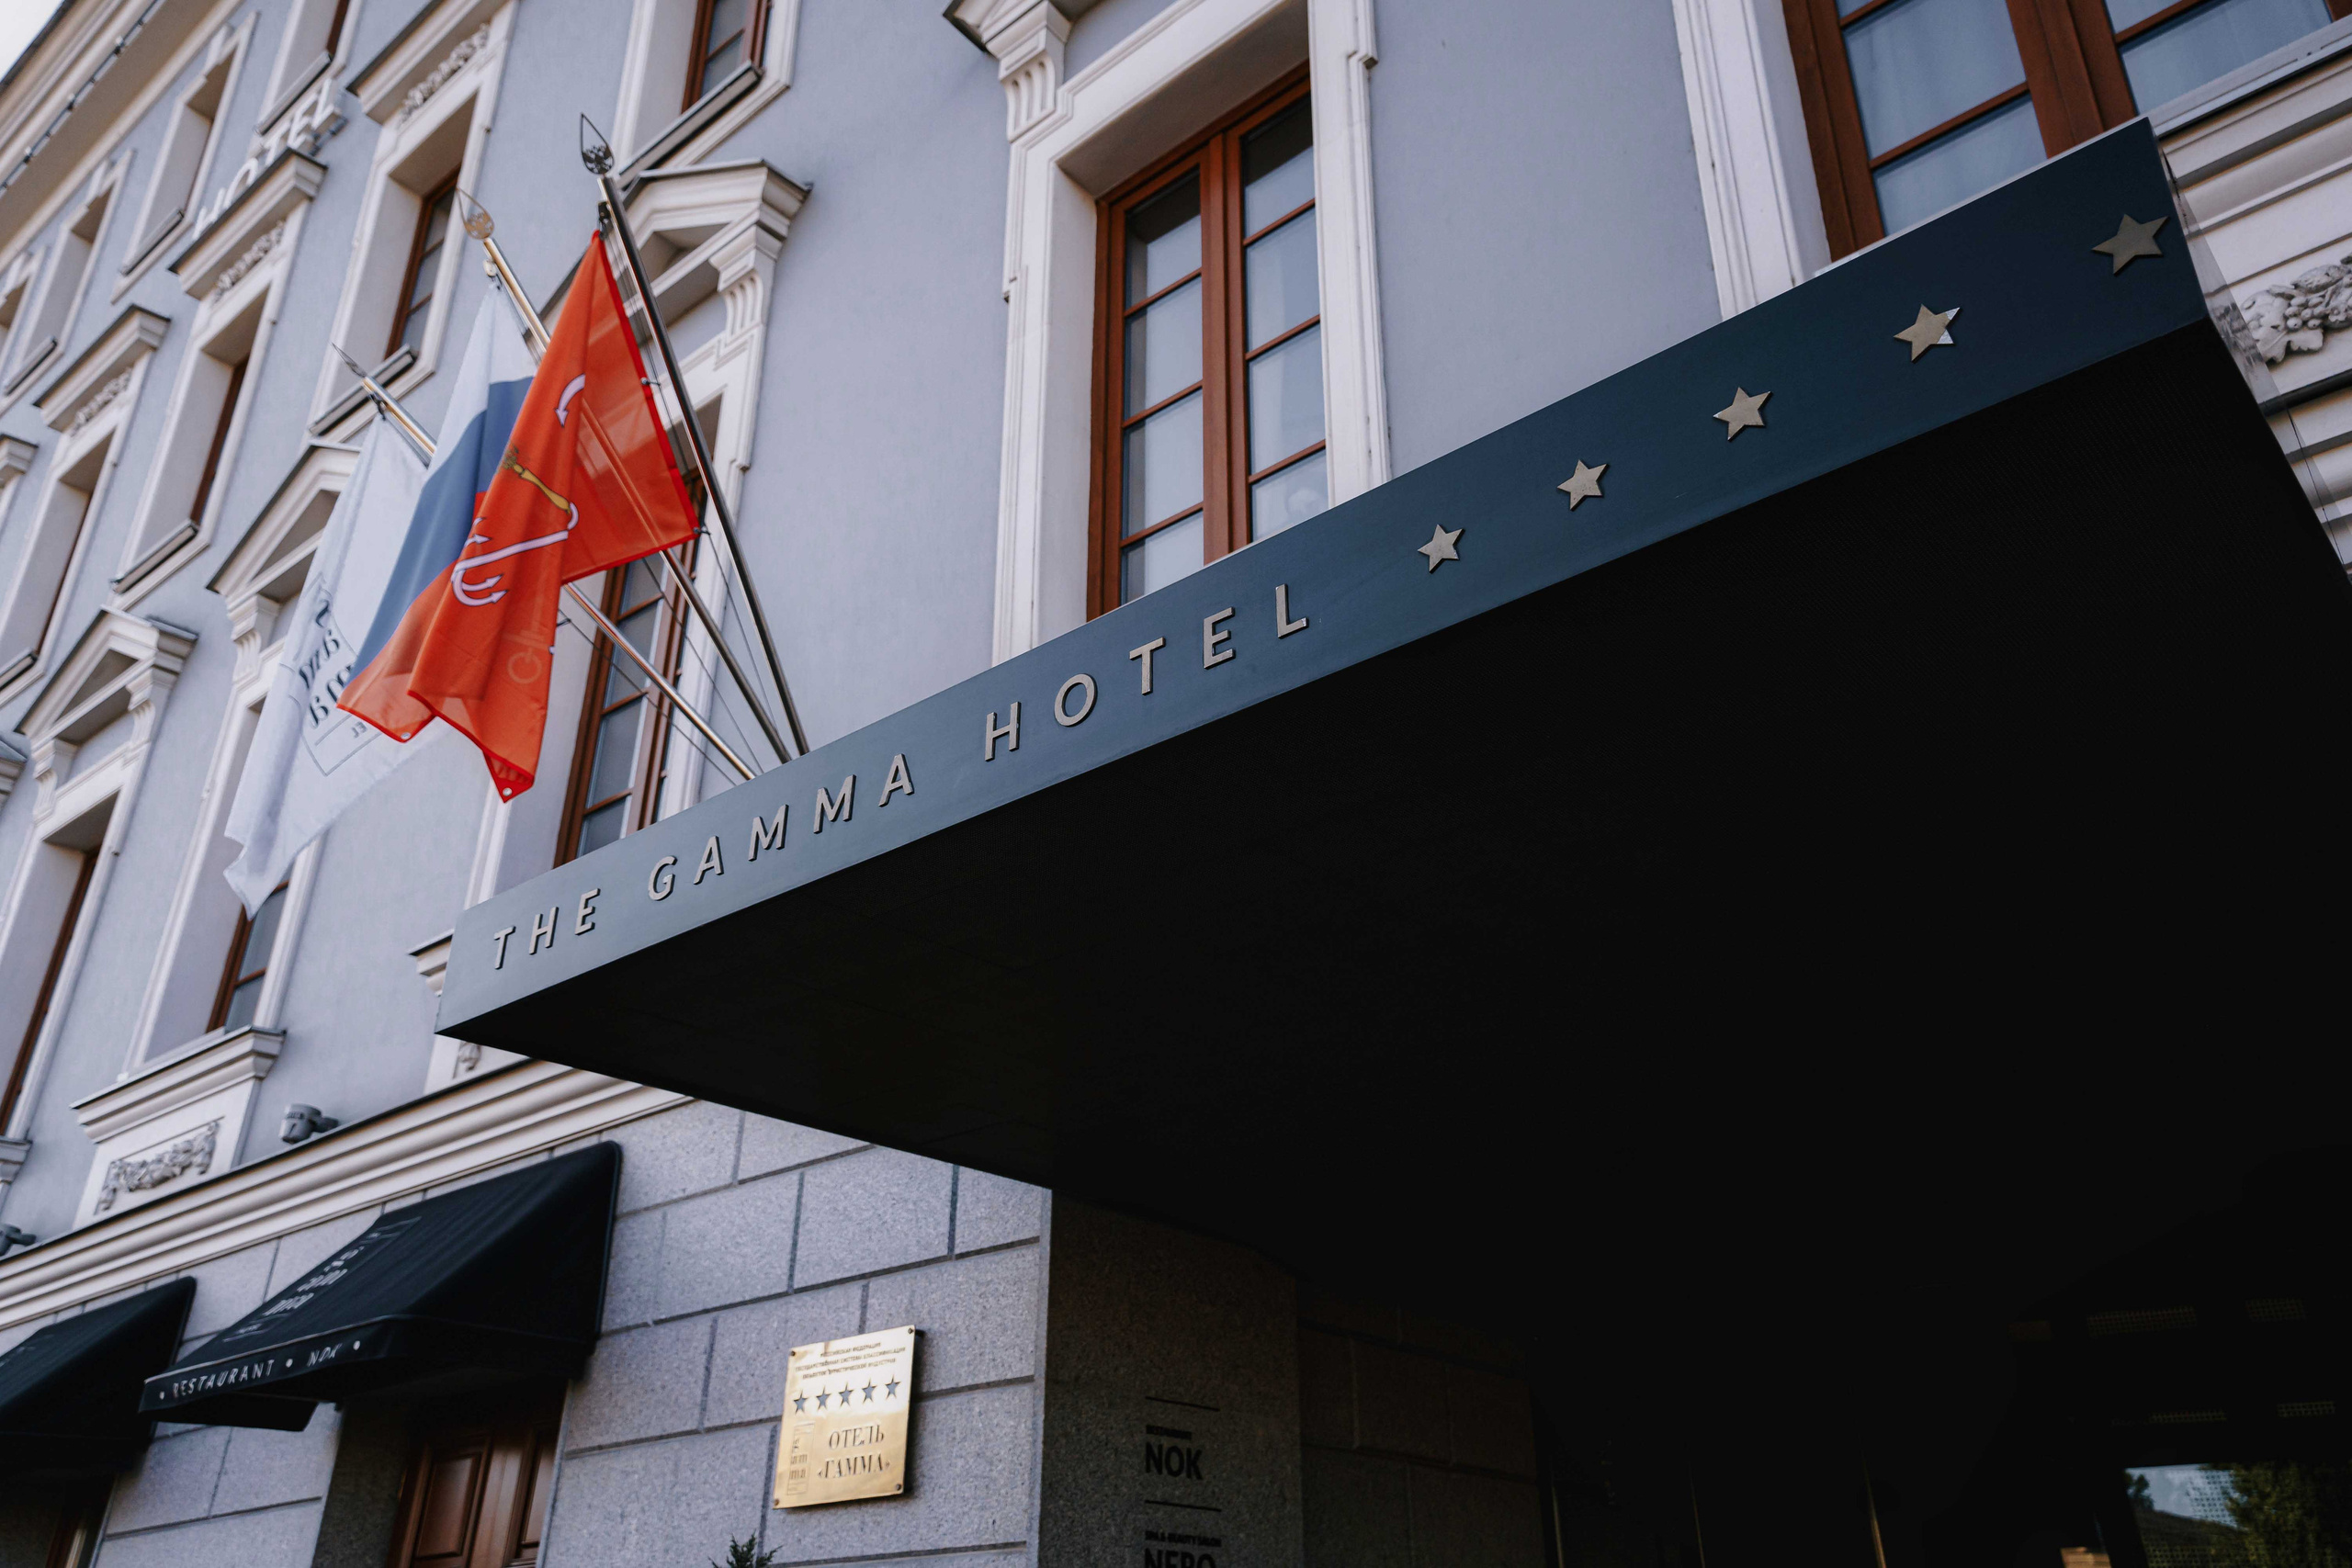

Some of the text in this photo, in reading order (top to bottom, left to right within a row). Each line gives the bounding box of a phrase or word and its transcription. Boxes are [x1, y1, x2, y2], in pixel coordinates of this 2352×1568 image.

[493, 583, 1308, 969] THE GAMMA HOTEL
[172, 1343, 343, 1398] RESTAURANT NOK
[829, 1424, 885, 1450] ОТЕЛЬ
[1145, 1441, 1203, 1481] NOK
